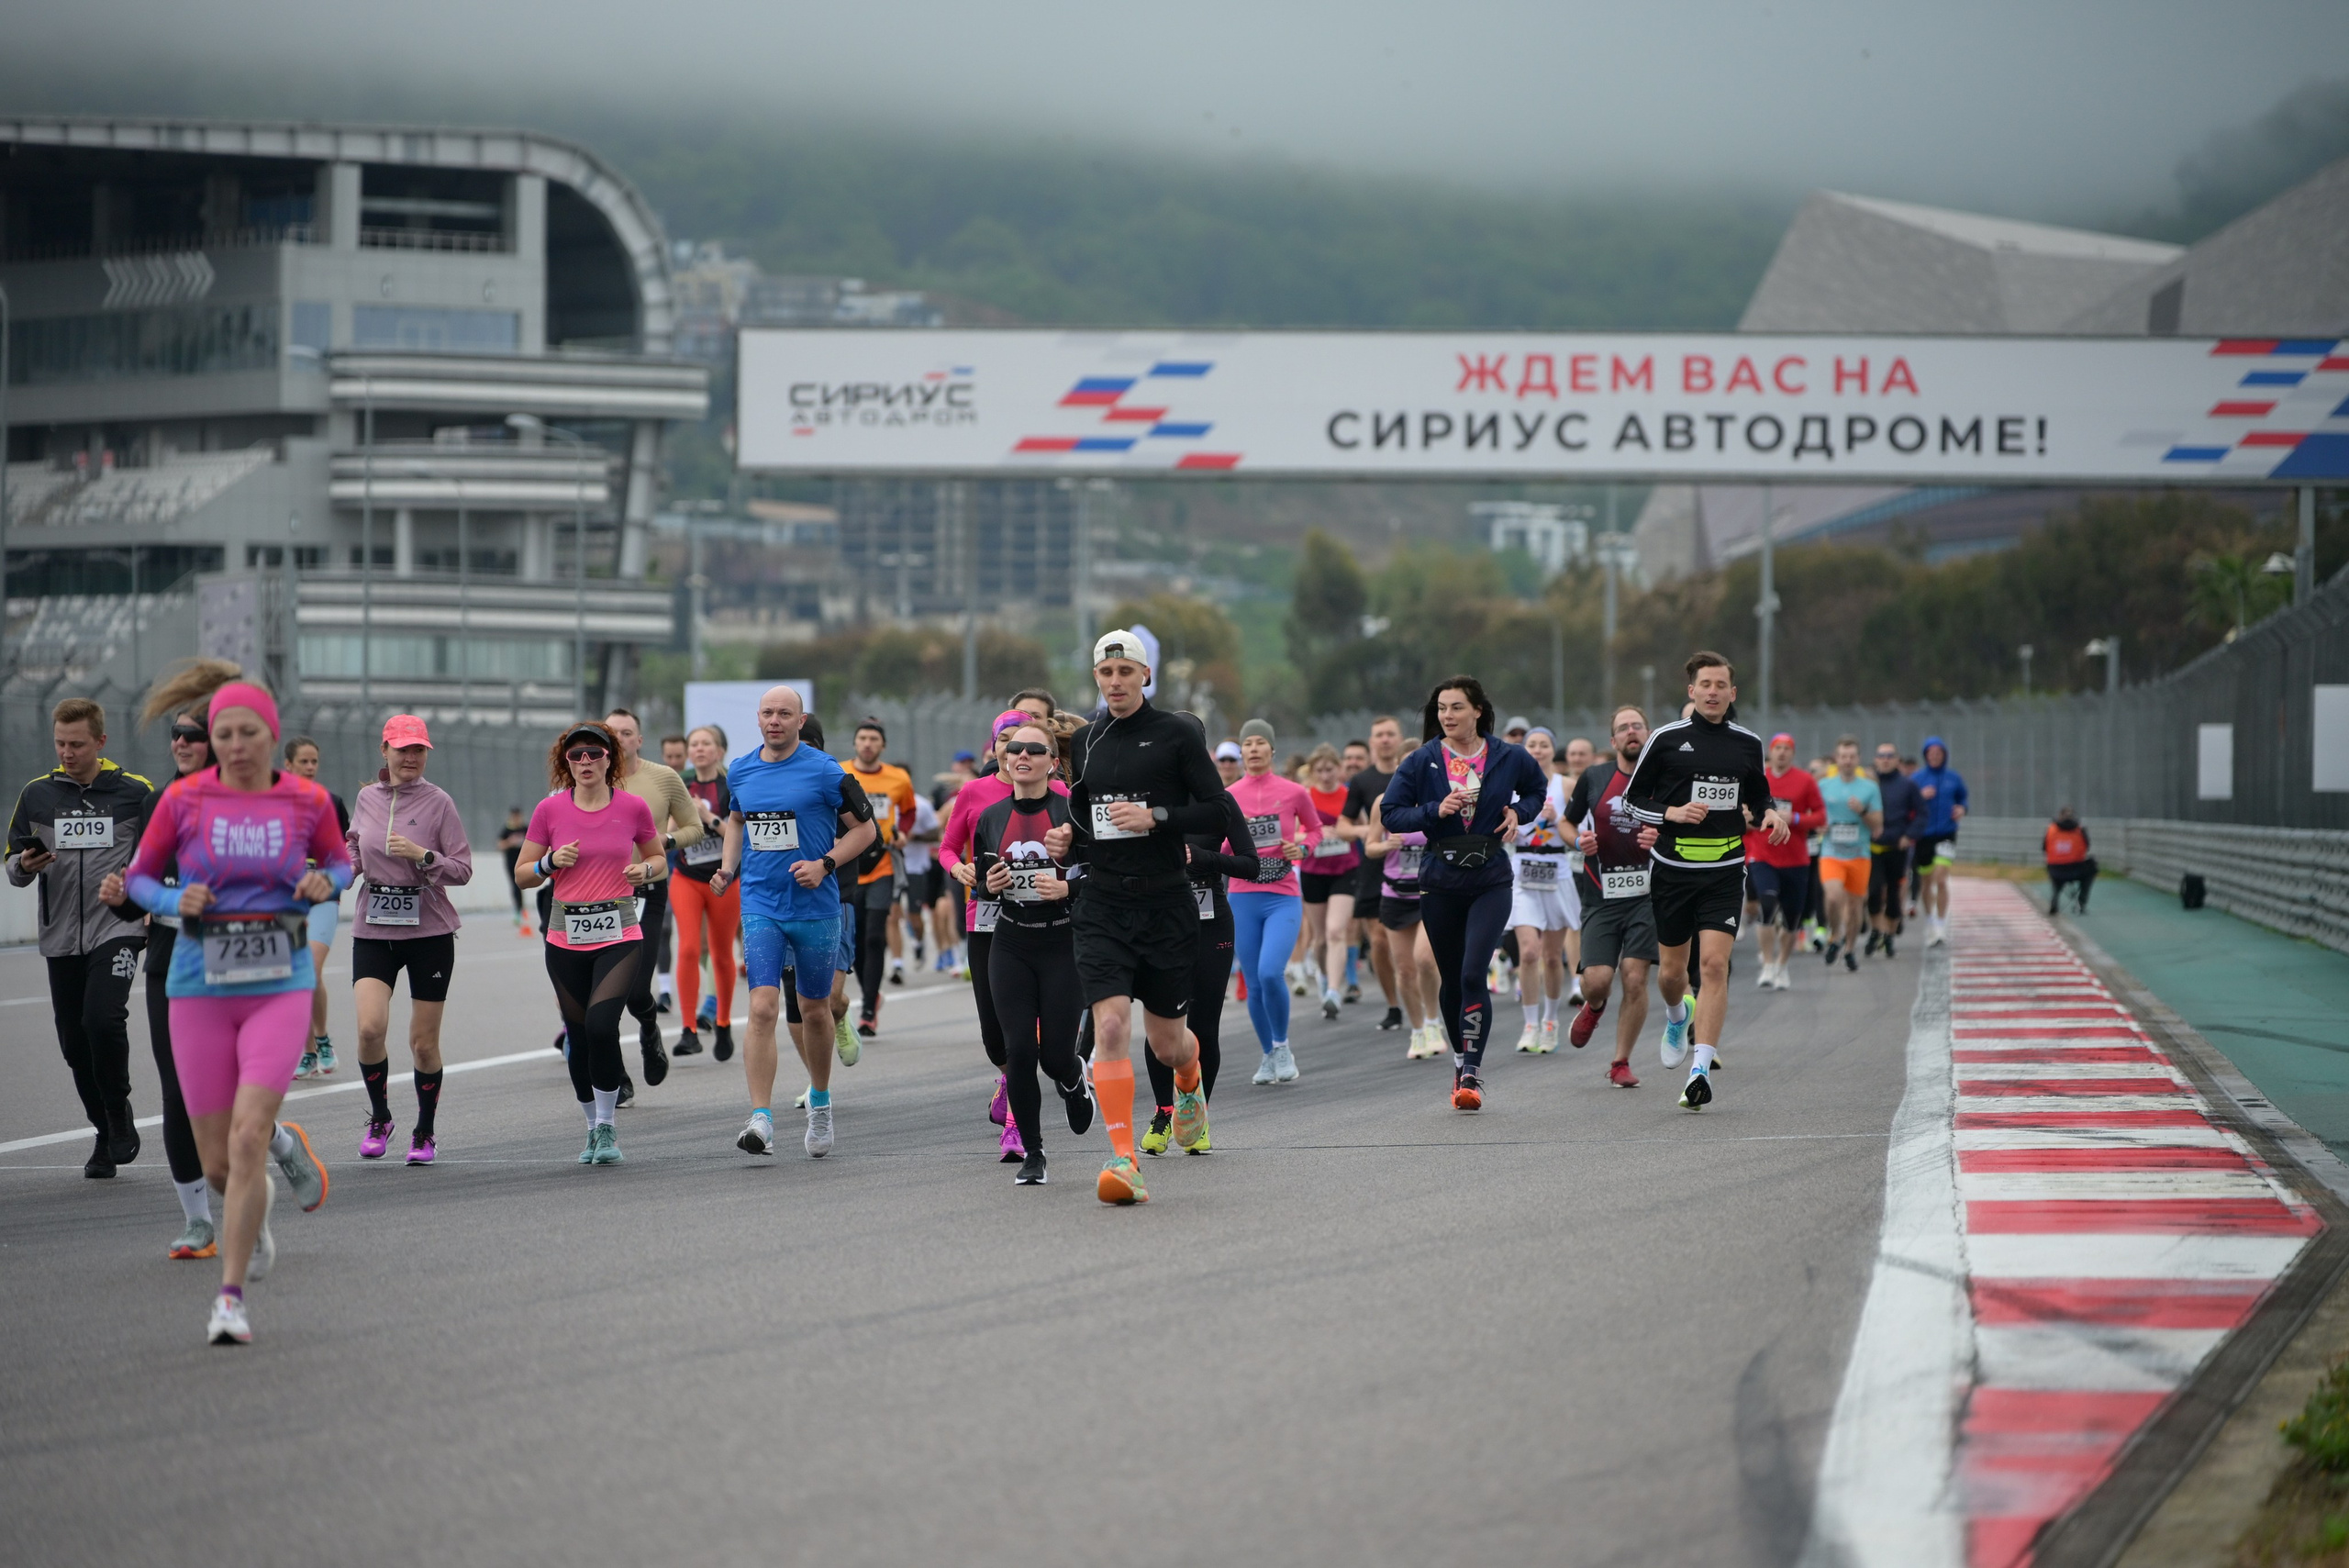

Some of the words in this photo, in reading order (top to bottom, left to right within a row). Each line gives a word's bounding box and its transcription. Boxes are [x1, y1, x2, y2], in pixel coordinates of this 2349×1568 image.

[1456, 352, 1654, 399] ЖДЕМ
[1682, 353, 1808, 395] ВАС
[1833, 355, 1920, 396] НА
[788, 383, 974, 407] СИРИУС
[1327, 411, 1589, 451] СИРИУС
[1613, 413, 2047, 461] АВТОДРОМЕ!
[1698, 786, 1735, 800] 8396
[62, 821, 105, 836] 2019
[752, 822, 788, 836] 7731
[1249, 823, 1276, 837] 338
[1523, 867, 1554, 879] 6859
[1608, 875, 1644, 888] 8268
[373, 895, 413, 910] 7205
[571, 916, 616, 933] 7942
[217, 936, 277, 961] 7231
[1463, 1004, 1483, 1052] FILA
